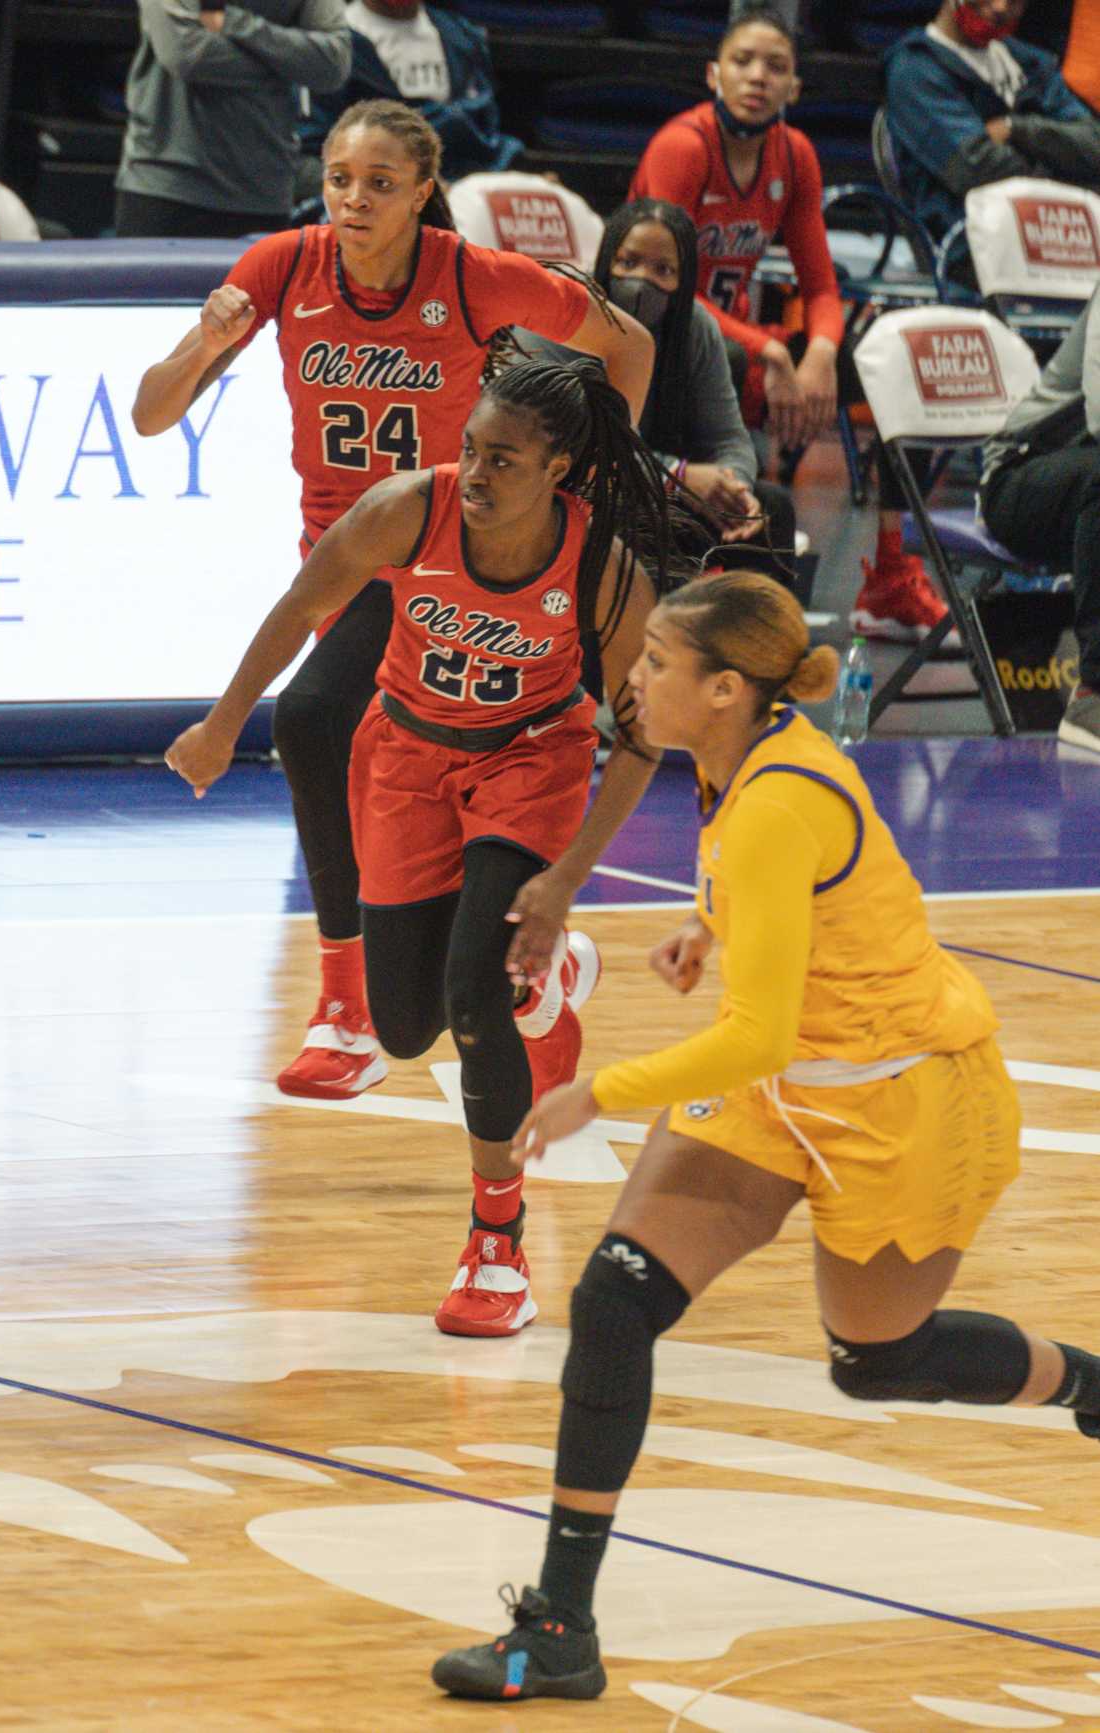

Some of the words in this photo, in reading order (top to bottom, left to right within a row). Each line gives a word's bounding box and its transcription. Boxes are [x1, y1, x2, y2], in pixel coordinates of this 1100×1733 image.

[300, 340, 355, 388] Ole
[355, 343, 445, 392] Miss
[918, 355, 992, 378] BUREAU
[932, 334, 985, 354] FARM
[319, 400, 422, 474] 24
[406, 594, 463, 639] Ole
[459, 611, 555, 660] Miss
[419, 638, 525, 706] 23
